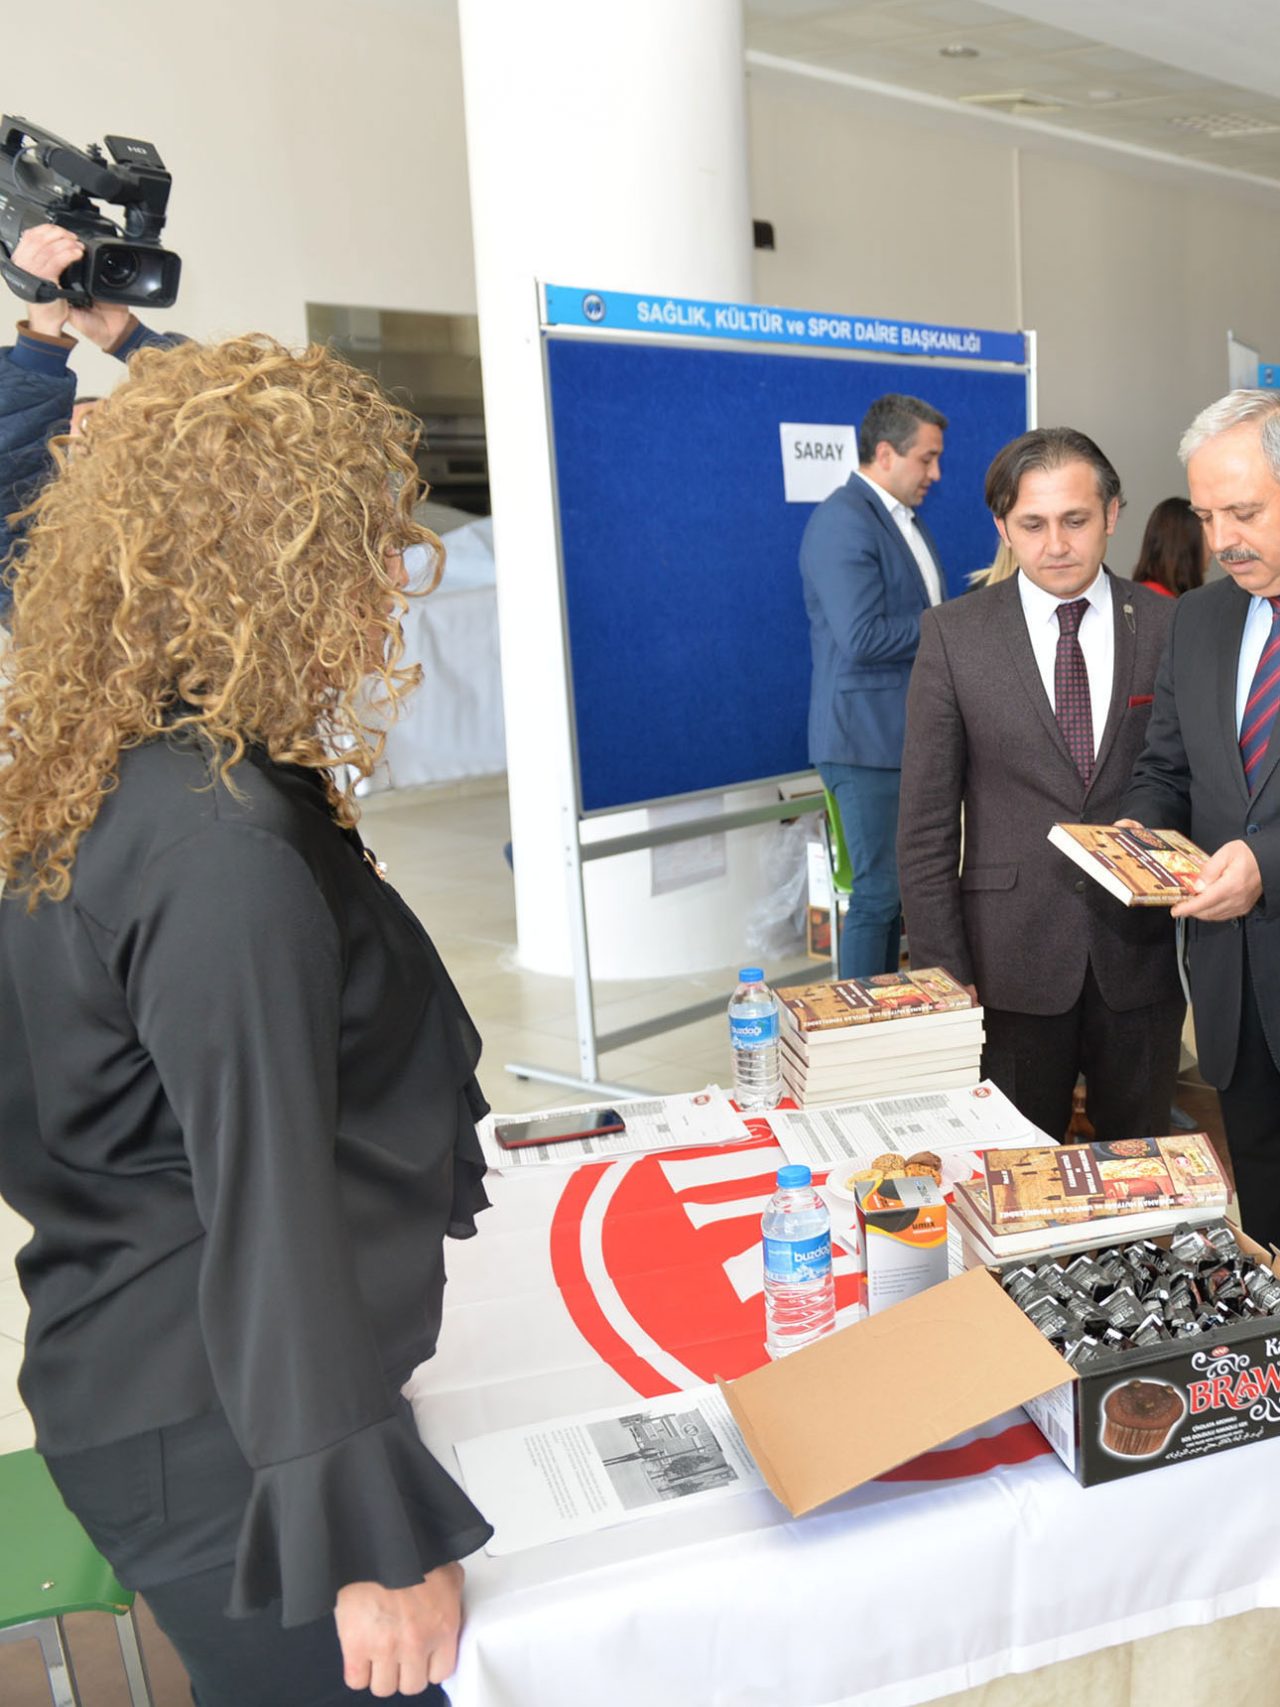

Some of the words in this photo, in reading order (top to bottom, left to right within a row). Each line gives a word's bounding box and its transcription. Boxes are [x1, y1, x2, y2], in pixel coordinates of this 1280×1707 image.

[637, 300, 711, 330] SAĞLIK,
[715, 304, 783, 334] KÜLTÜR
[786, 321, 805, 336] ve
[808, 318, 852, 340] SPOR
[855, 322, 898, 346] DAİRE
[901, 326, 981, 354] BAŞKANLIĞI
[794, 440, 844, 462] SARAY
